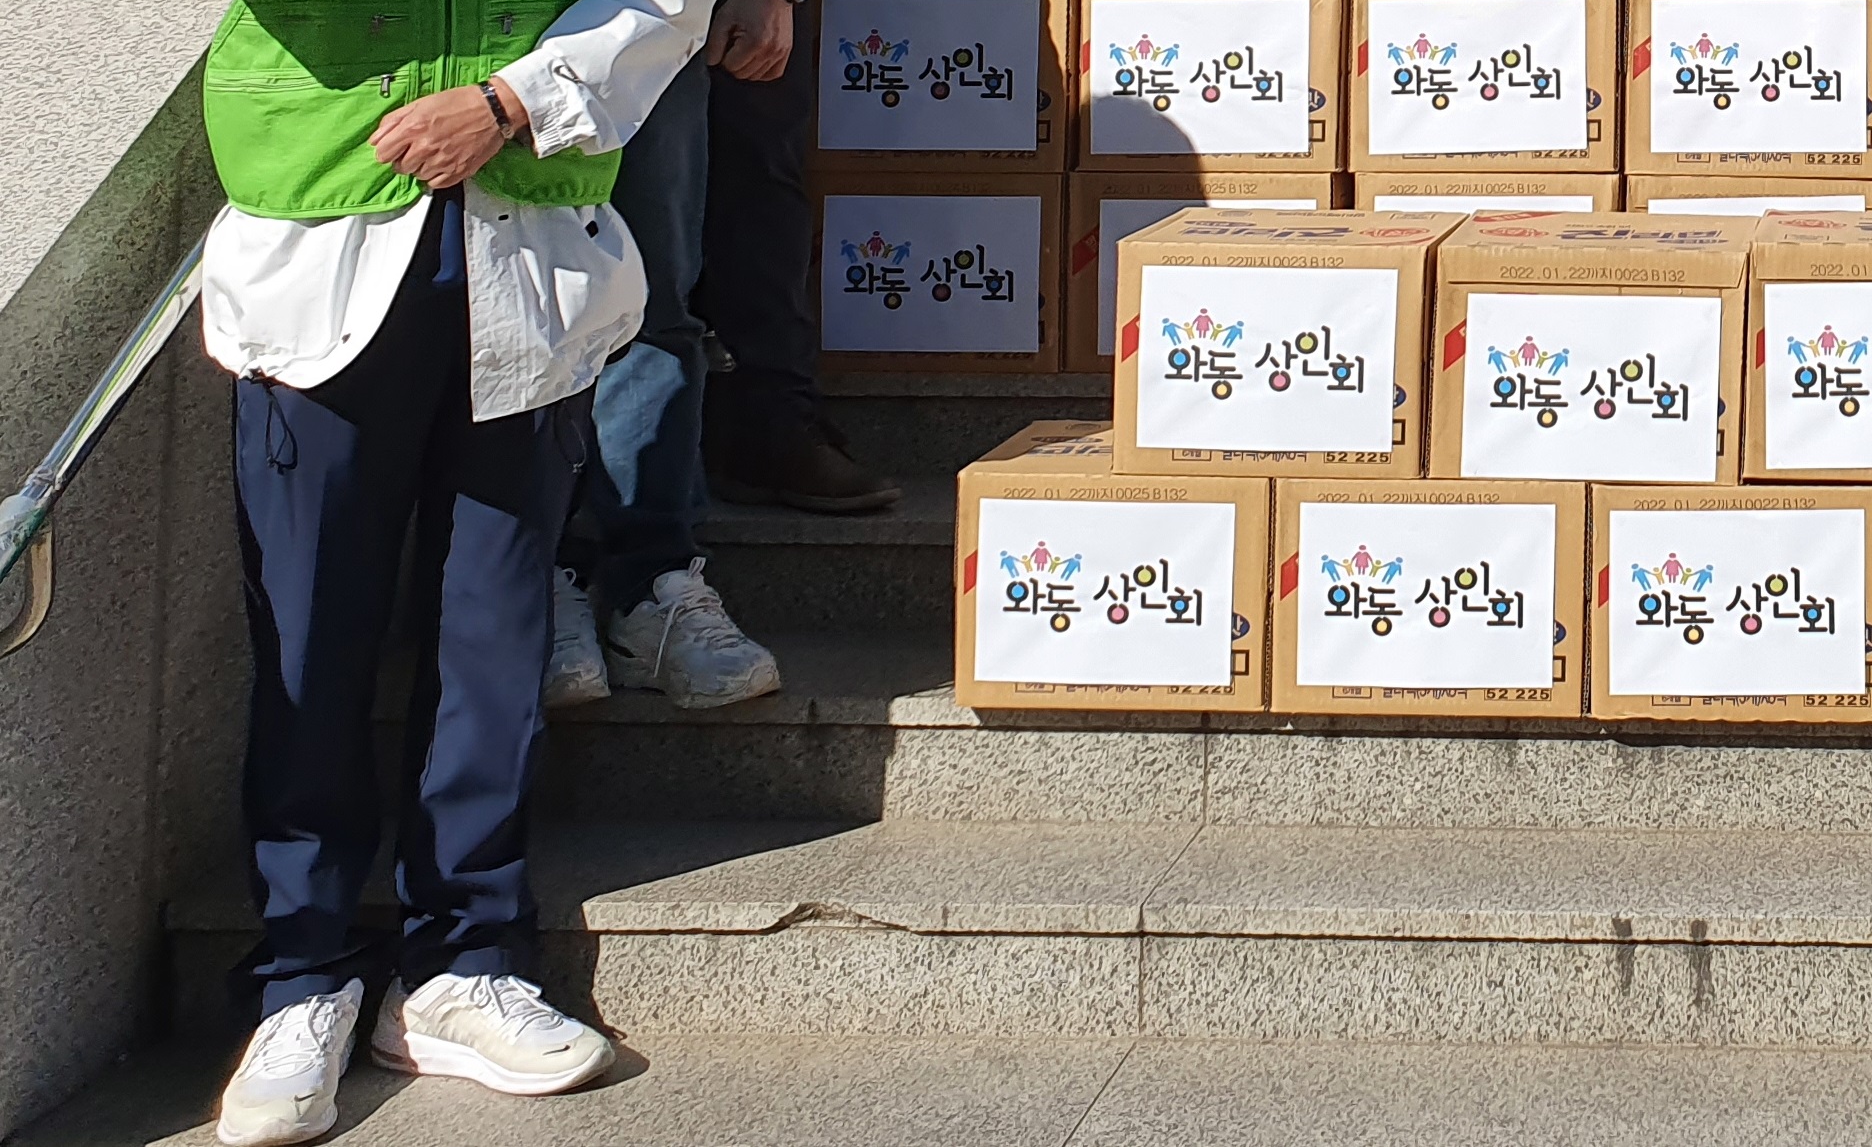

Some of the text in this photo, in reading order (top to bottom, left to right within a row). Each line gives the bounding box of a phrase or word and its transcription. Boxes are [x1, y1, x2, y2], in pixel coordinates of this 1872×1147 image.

[842, 43, 1012, 107] 와동 상인회
[1113, 47, 1282, 111] 와동 상인회
[1392, 44, 1560, 109] 와동 상인회
[1674, 46, 1841, 109] 와동 상인회
[844, 245, 1013, 309] 와동 상인회
[1165, 326, 1363, 399] 와동 상인회
[1491, 354, 1688, 427] 와동 상인회
[1792, 364, 1869, 416] 와동
[1004, 560, 1201, 632] 와동 상인회
[1325, 562, 1523, 636] 와동 상인회
[1636, 568, 1834, 644] 와동 상인회
